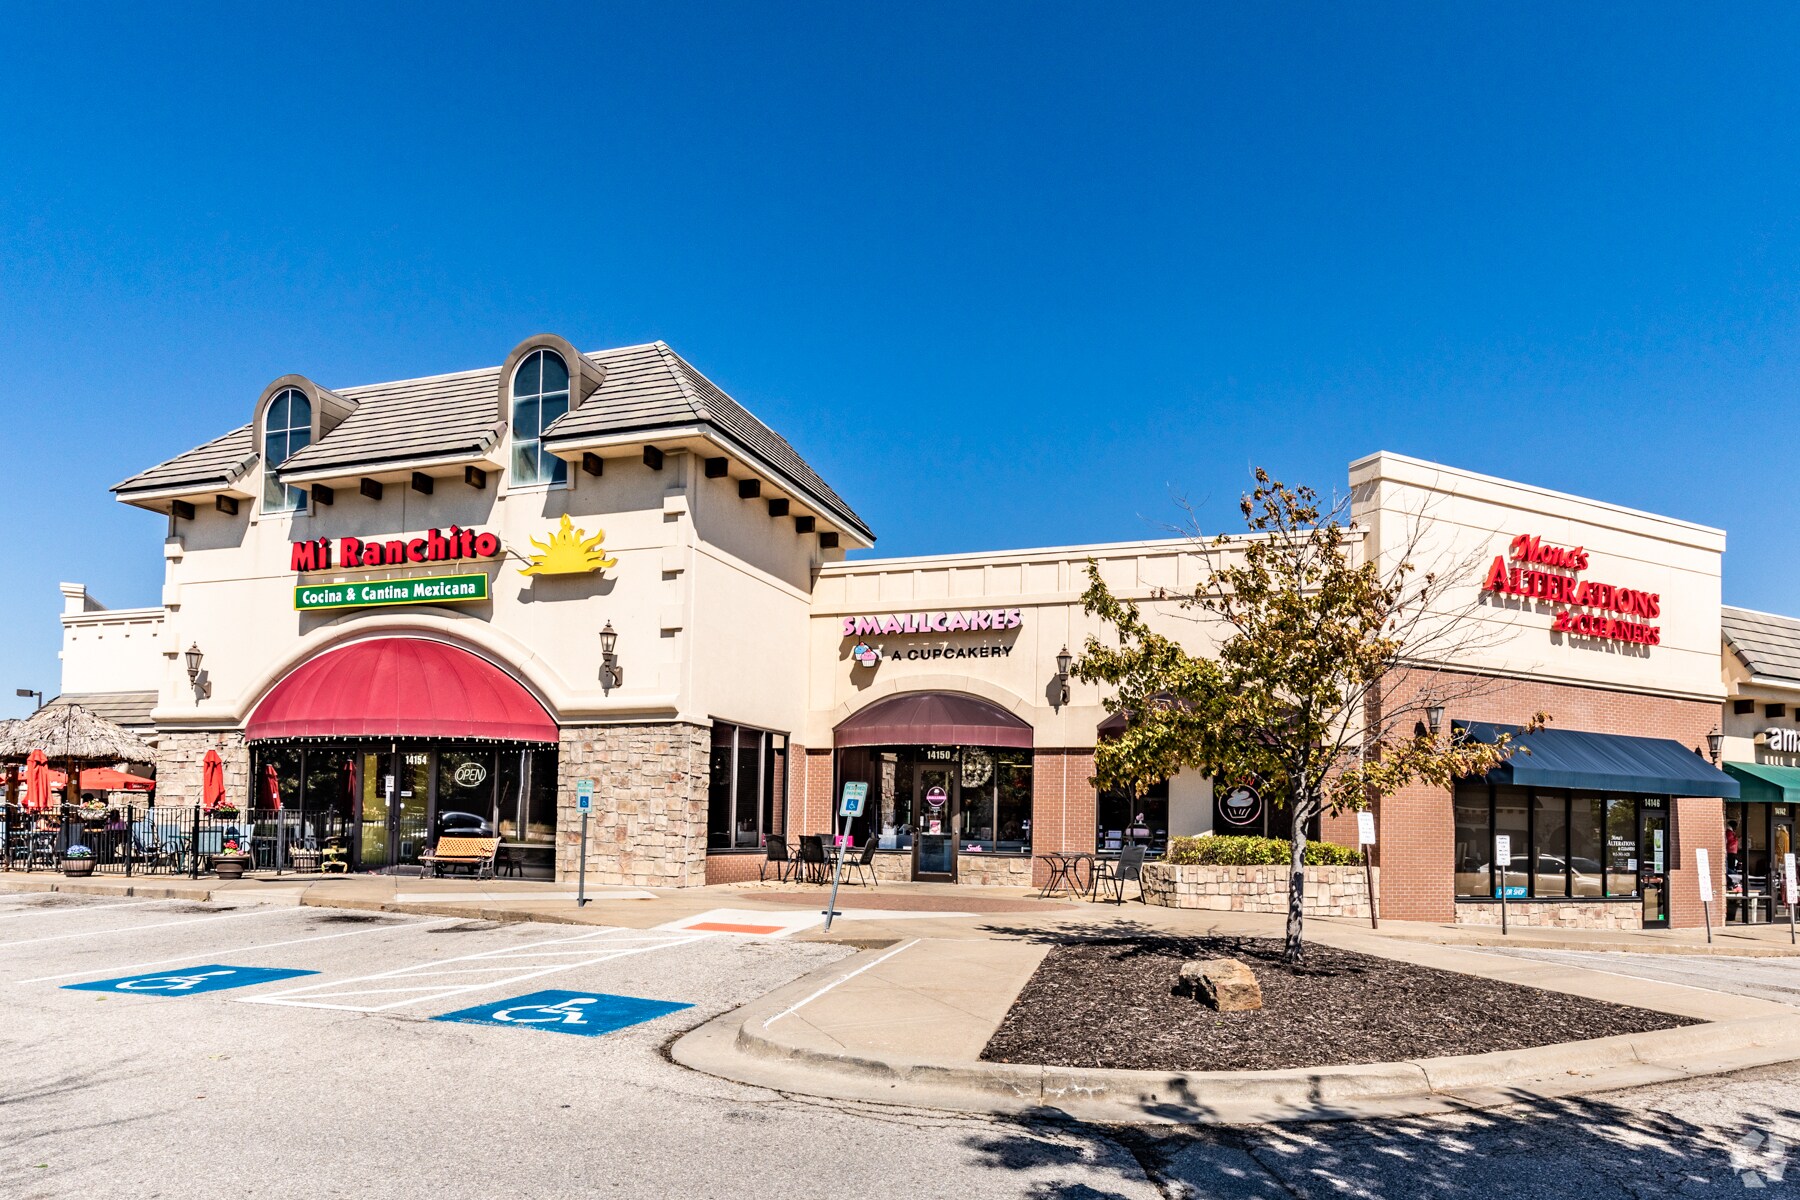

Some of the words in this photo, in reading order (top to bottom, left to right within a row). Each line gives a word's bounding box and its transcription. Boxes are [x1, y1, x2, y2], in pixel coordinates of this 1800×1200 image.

[291, 536, 332, 572] Mi
[340, 524, 501, 567] Ranchito
[302, 586, 342, 604] Cocina
[346, 587, 356, 601] &
[361, 584, 409, 601] Cantina
[414, 582, 475, 597] Mexicana
[842, 608, 1022, 636] SMALLCAKES
[1553, 610, 1573, 632] &
[1572, 614, 1660, 646] CLEANERS
[891, 650, 902, 661] A
[907, 646, 1014, 661] CUPCAKERY
[405, 755, 427, 765] 14154
[926, 750, 951, 760] 14150
[457, 768, 484, 781] OPEN
[1644, 798, 1661, 808] 14146
